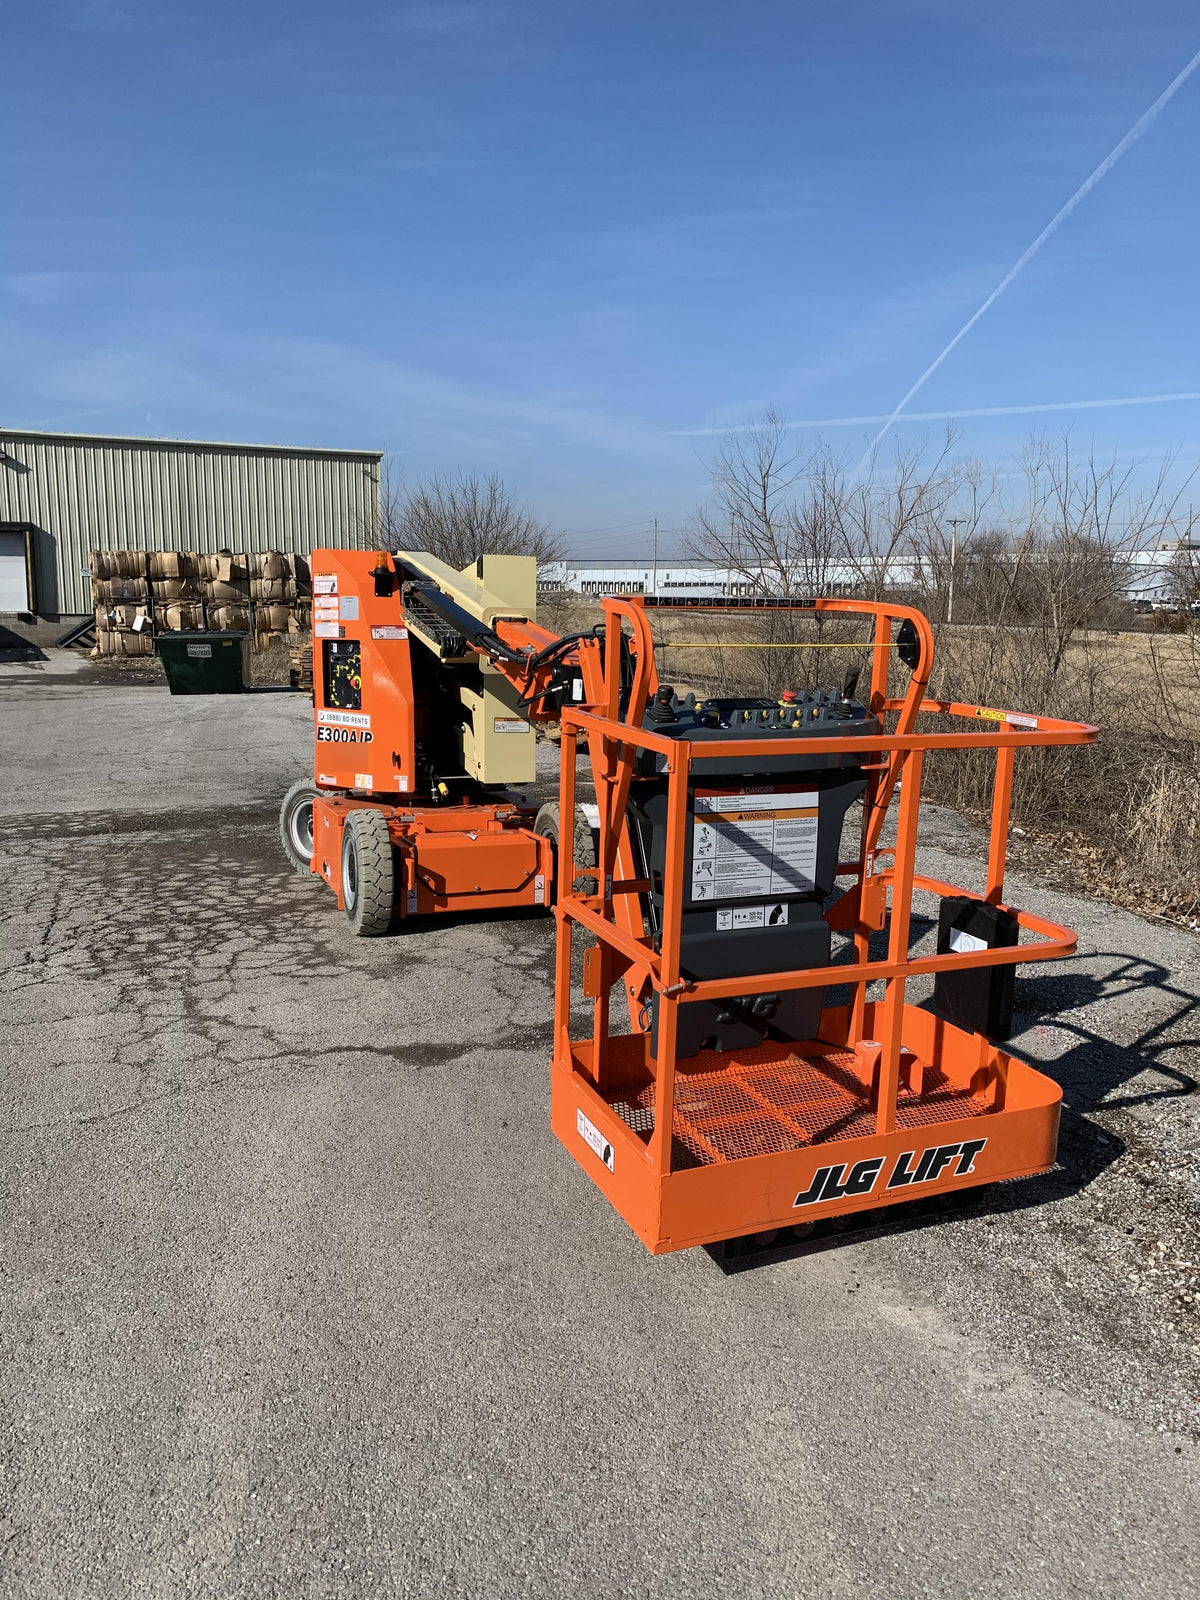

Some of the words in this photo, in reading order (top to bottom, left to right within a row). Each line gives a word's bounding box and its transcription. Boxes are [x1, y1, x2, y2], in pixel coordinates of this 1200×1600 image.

[981, 709, 1005, 721] CAUTION
[745, 786, 775, 794] DANGER
[743, 811, 777, 820] WARNING
[792, 1156, 887, 1208] JLG
[886, 1137, 989, 1190] LIFT
